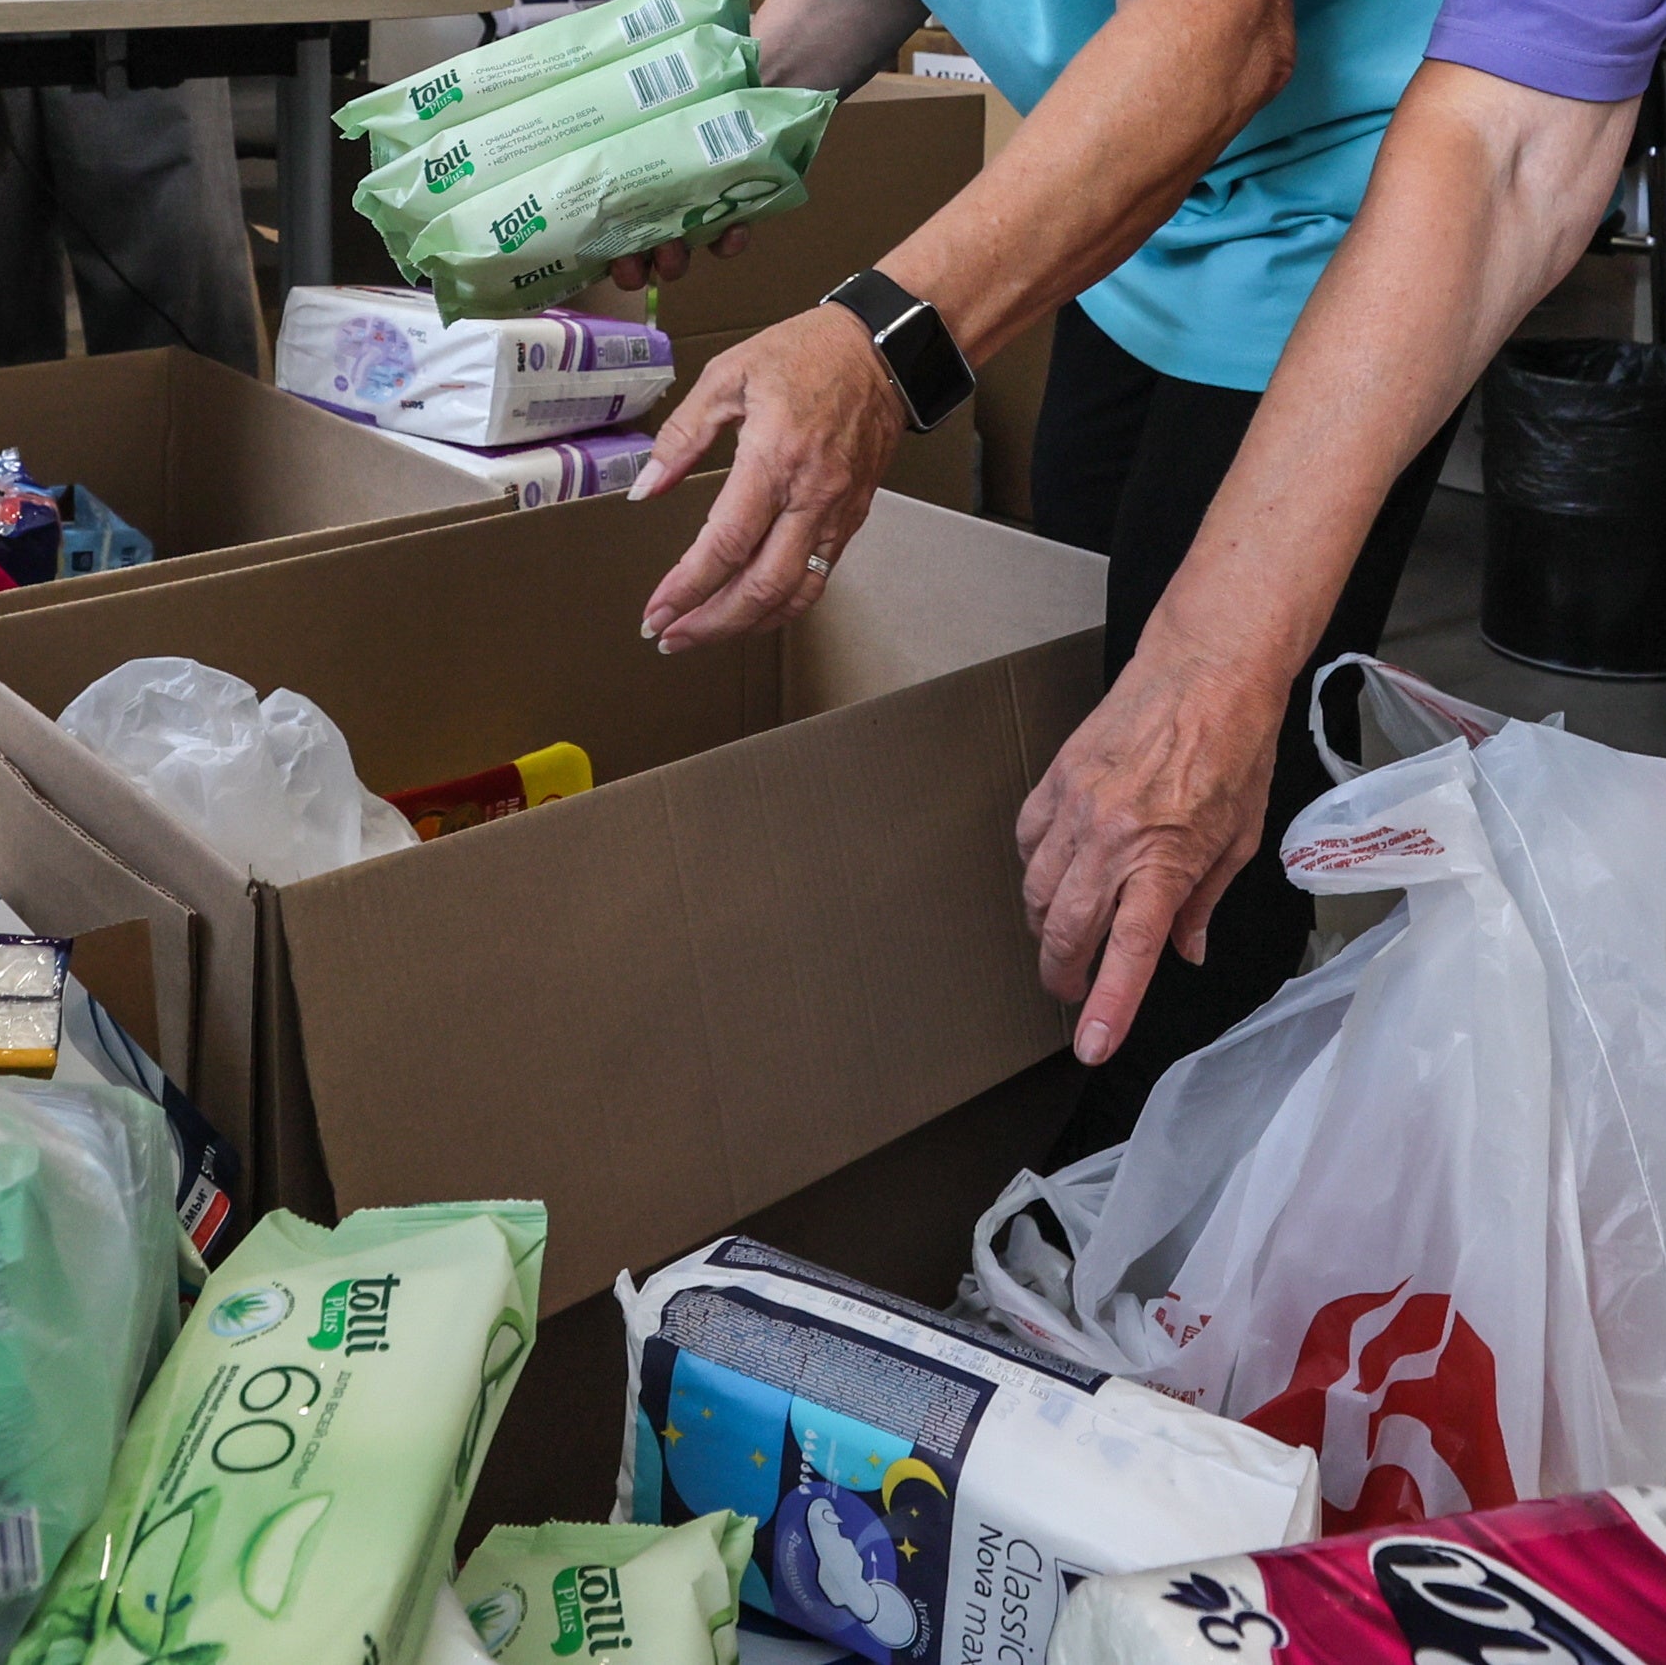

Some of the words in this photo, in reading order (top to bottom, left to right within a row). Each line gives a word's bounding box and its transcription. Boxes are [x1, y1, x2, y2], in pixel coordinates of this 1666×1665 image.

[475, 53, 535, 76] ОЧИЩАЮЩИЕ
[481, 67, 543, 95] НЕЙТРАЛЬНЫЙ
[543, 56, 581, 74] УРОВЕНЬ
[486, 60, 541, 83] ЭКСТРАКТОМ
[541, 52, 566, 66] АЛОЭ
[566, 43, 587, 58] ВЕРА
[409, 67, 461, 112] tolli
[429, 89, 454, 117] Plus
[485, 116, 543, 147] ОЧИЩАЮЩИЕ
[492, 136, 554, 167] НЕЙТРАЛЬНЫЙ
[553, 120, 591, 143] УРОВЕНЬ
[496, 126, 551, 153] ЭКСТРАКТОМ
[550, 117, 576, 131] АЛОЭ
[575, 106, 599, 122] ВЕРА
[423, 139, 472, 185] tolli
[440, 167, 466, 191] Plus
[567, 176, 619, 207] ЭКСТРАКТОМ
[618, 166, 644, 182] АЛОЭ
[644, 158, 667, 172] ВЕРА
[555, 167, 614, 200] ОЧИЩАЮЩИЕ
[622, 173, 661, 194] УРОВЕНЬ
[489, 193, 543, 245] tolli
[512, 221, 538, 249] Plus
[509, 258, 566, 291] tolli
[516, 339, 527, 373] seni
[322, 1295, 346, 1335] Plus
[344, 1272, 401, 1358] tolli
[210, 1364, 322, 1475] 60
[974, 1522, 1004, 1599] Nova
[556, 1587, 577, 1635] Plus
[577, 1564, 633, 1658] tolli
[997, 1538, 1043, 1665] Classic
